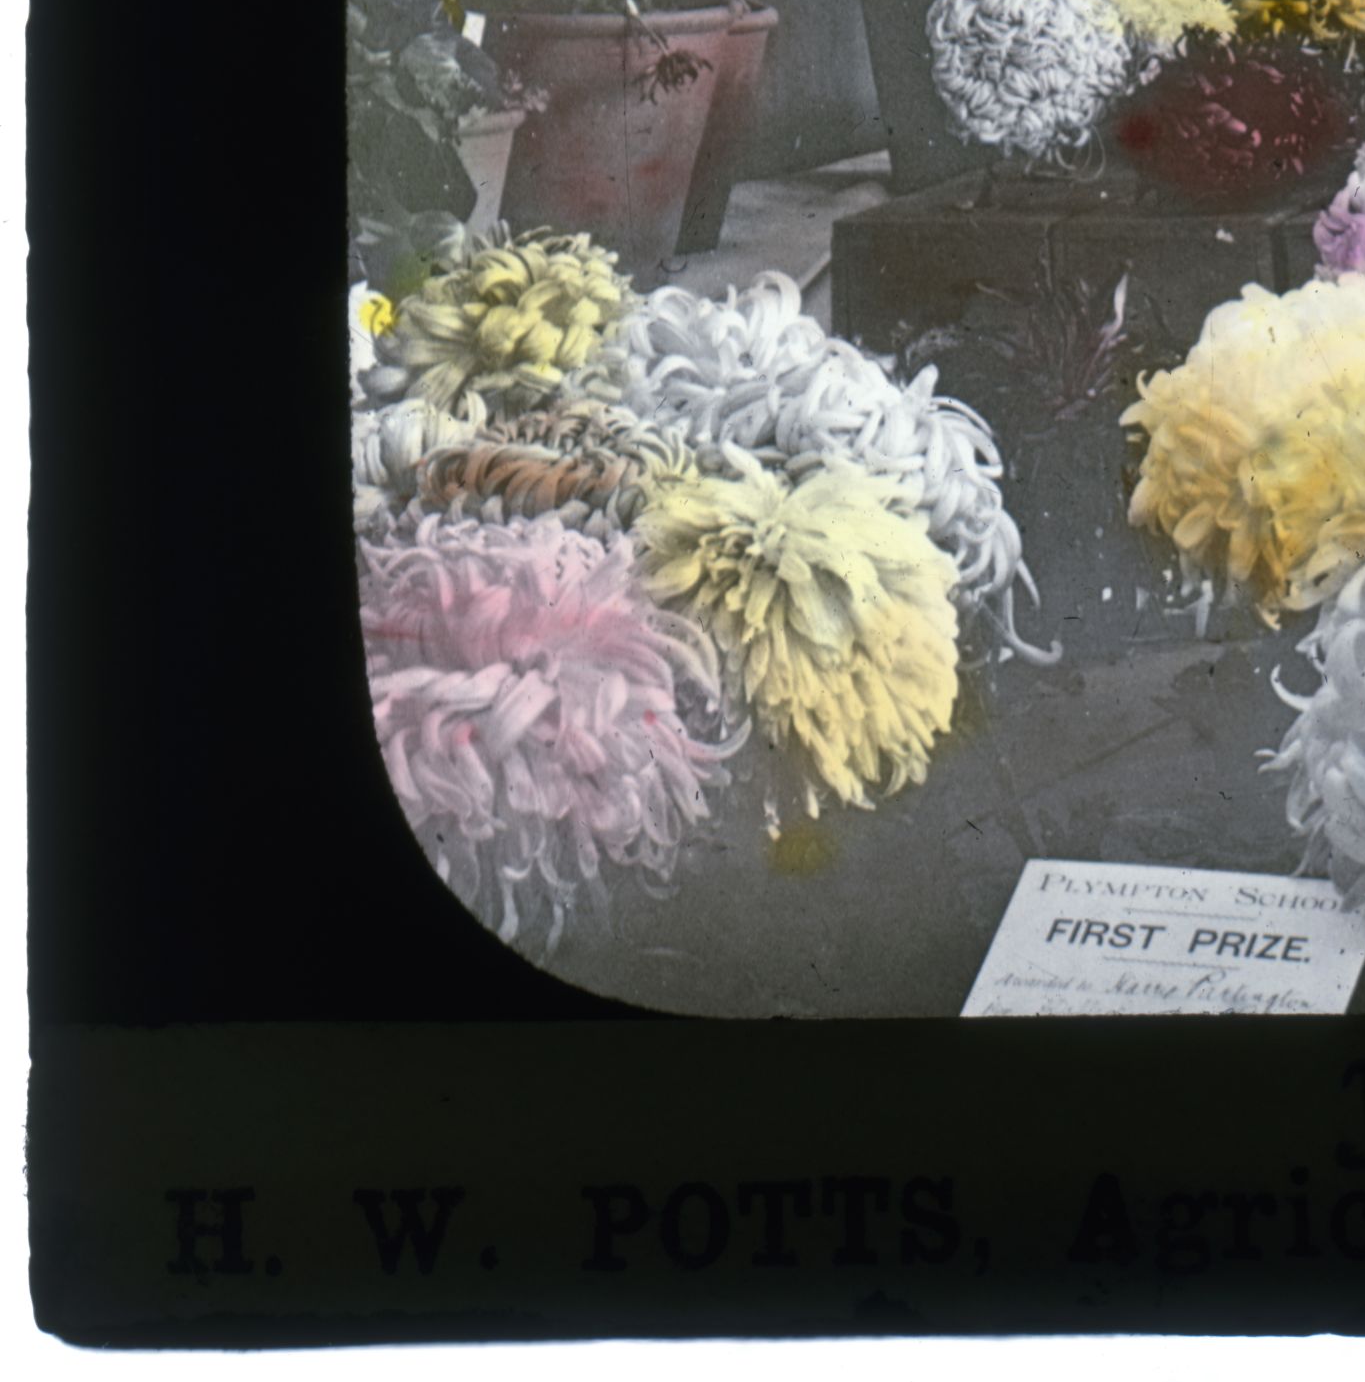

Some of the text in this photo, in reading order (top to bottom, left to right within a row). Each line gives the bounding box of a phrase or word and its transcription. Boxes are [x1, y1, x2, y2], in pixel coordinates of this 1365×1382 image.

[1234, 886, 1345, 911] SCHOO
[1046, 919, 1312, 964] FIRST PRIZE.
[165, 1189, 284, 1277] H.
[354, 1187, 503, 1277] W.
[580, 1177, 992, 1279] POTTS,
